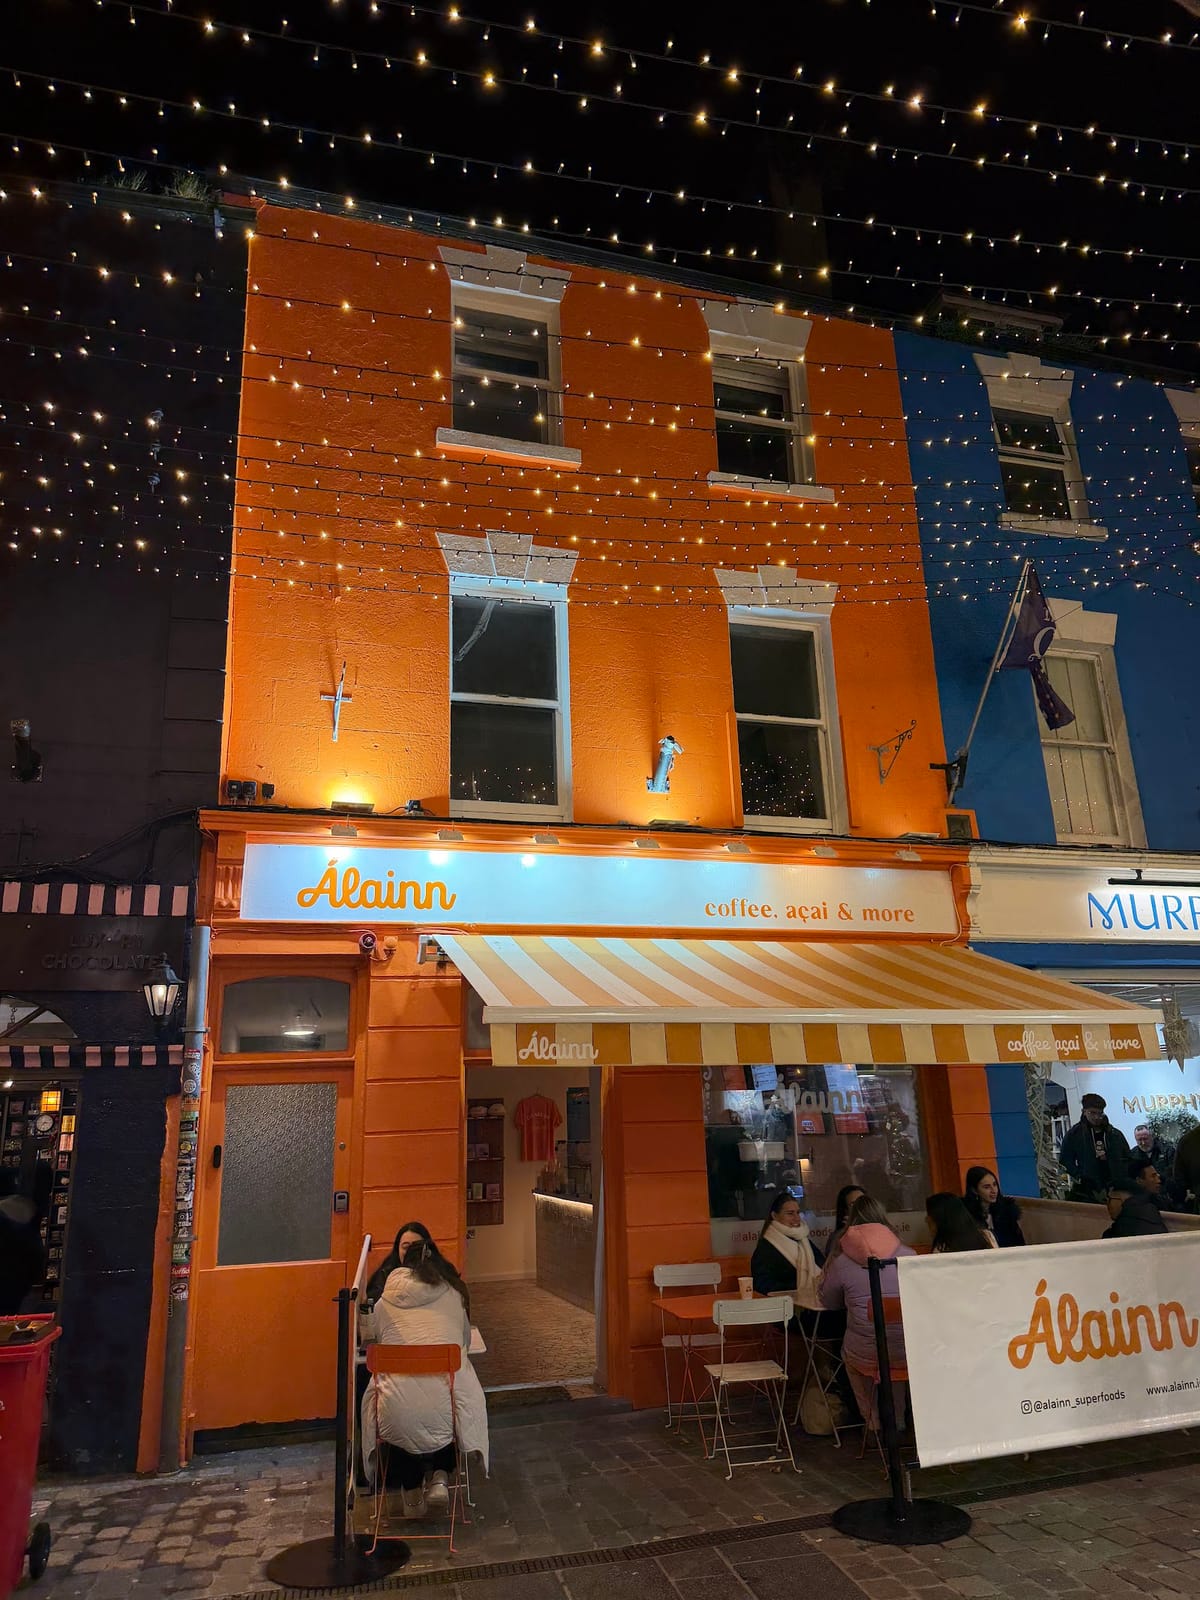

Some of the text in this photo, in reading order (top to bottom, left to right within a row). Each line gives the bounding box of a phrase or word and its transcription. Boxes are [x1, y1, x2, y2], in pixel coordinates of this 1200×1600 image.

[297, 858, 456, 910] Álainn
[786, 901, 828, 923] açai
[837, 902, 854, 921] &
[862, 907, 915, 923] more
[519, 1031, 599, 1060] Álainn
[1007, 1031, 1142, 1058] coffee açai & more
[1007, 1278, 1200, 1369] Álainn
[1033, 1379, 1200, 1413] @alainn_superfoods www.alainn.i
